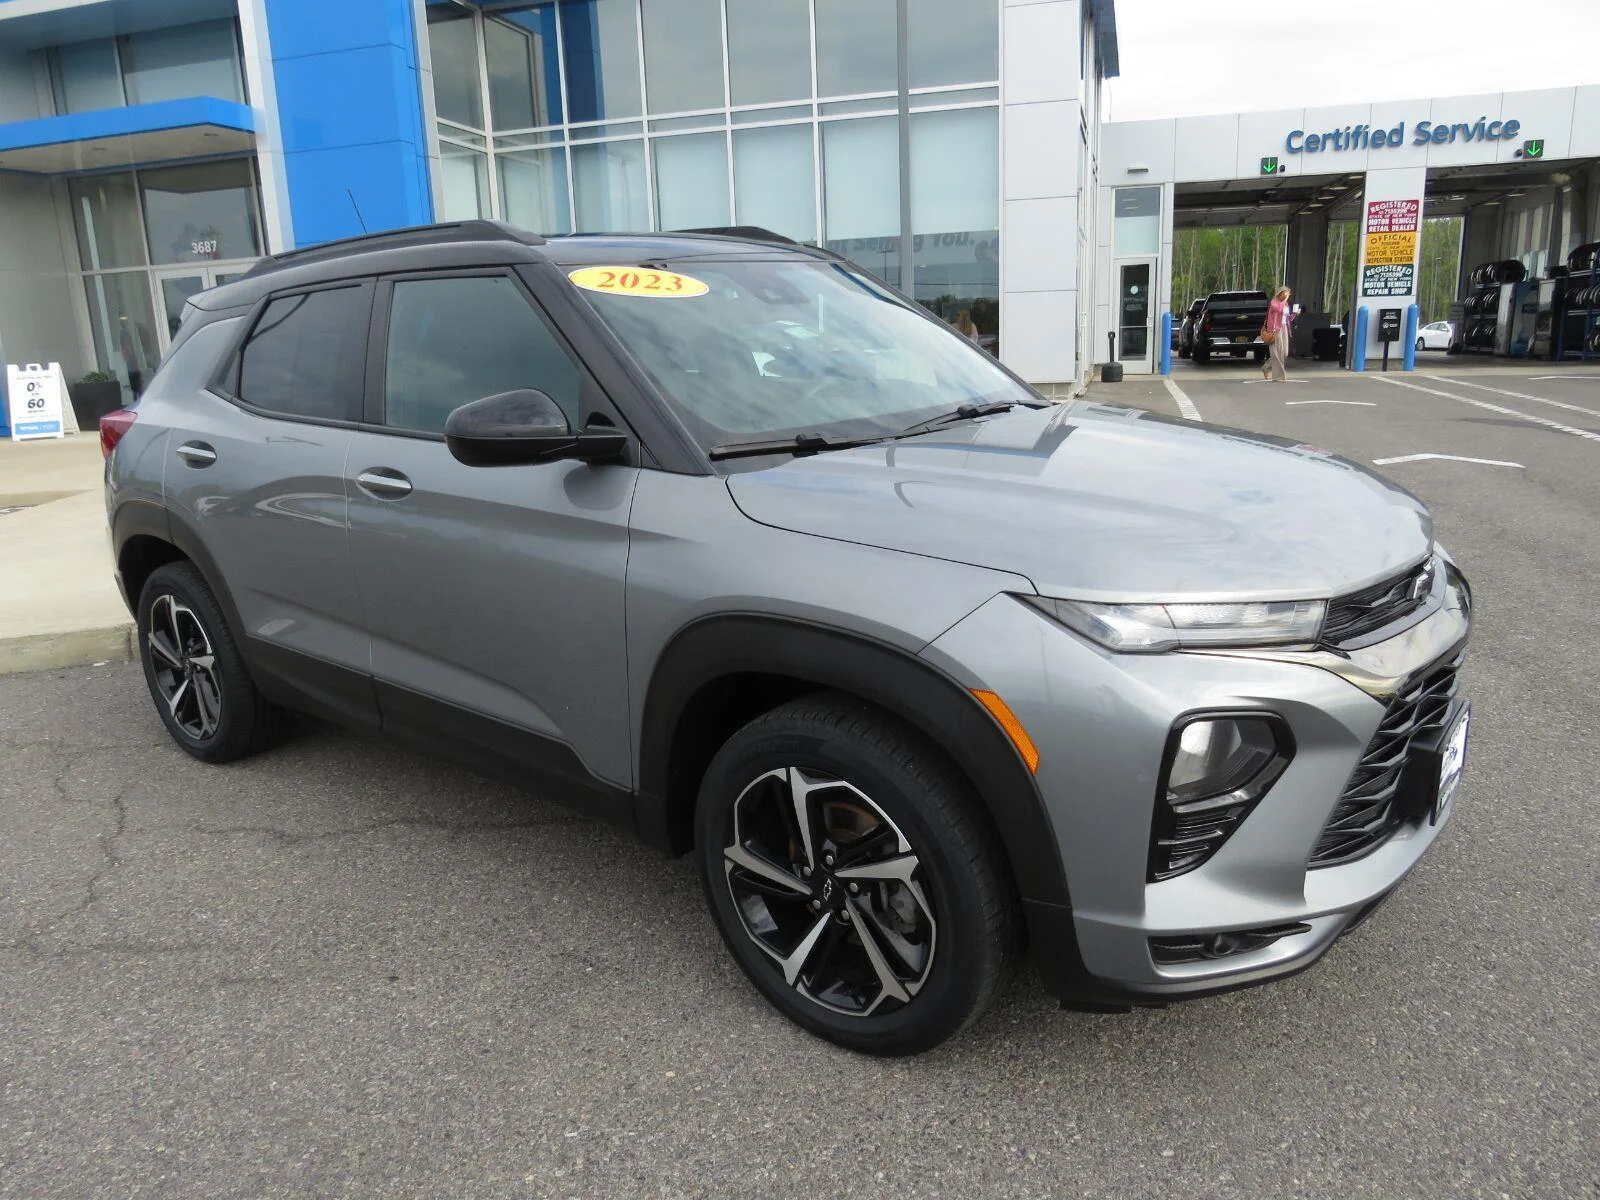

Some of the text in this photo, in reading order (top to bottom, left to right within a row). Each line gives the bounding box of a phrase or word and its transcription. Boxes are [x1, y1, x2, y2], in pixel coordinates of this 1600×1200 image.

[1286, 116, 1521, 154] Certified Service
[1370, 201, 1417, 214] REGISTERED
[1369, 217, 1416, 226] MOTOR VEHICLE
[1370, 234, 1412, 244] OFFICIAL
[191, 240, 217, 254] 3687
[1365, 265, 1412, 276] REGISTERED
[597, 271, 683, 291] 2023
[1364, 280, 1412, 289] MOTOR VEHICLE
[27, 398, 45, 409] 60
